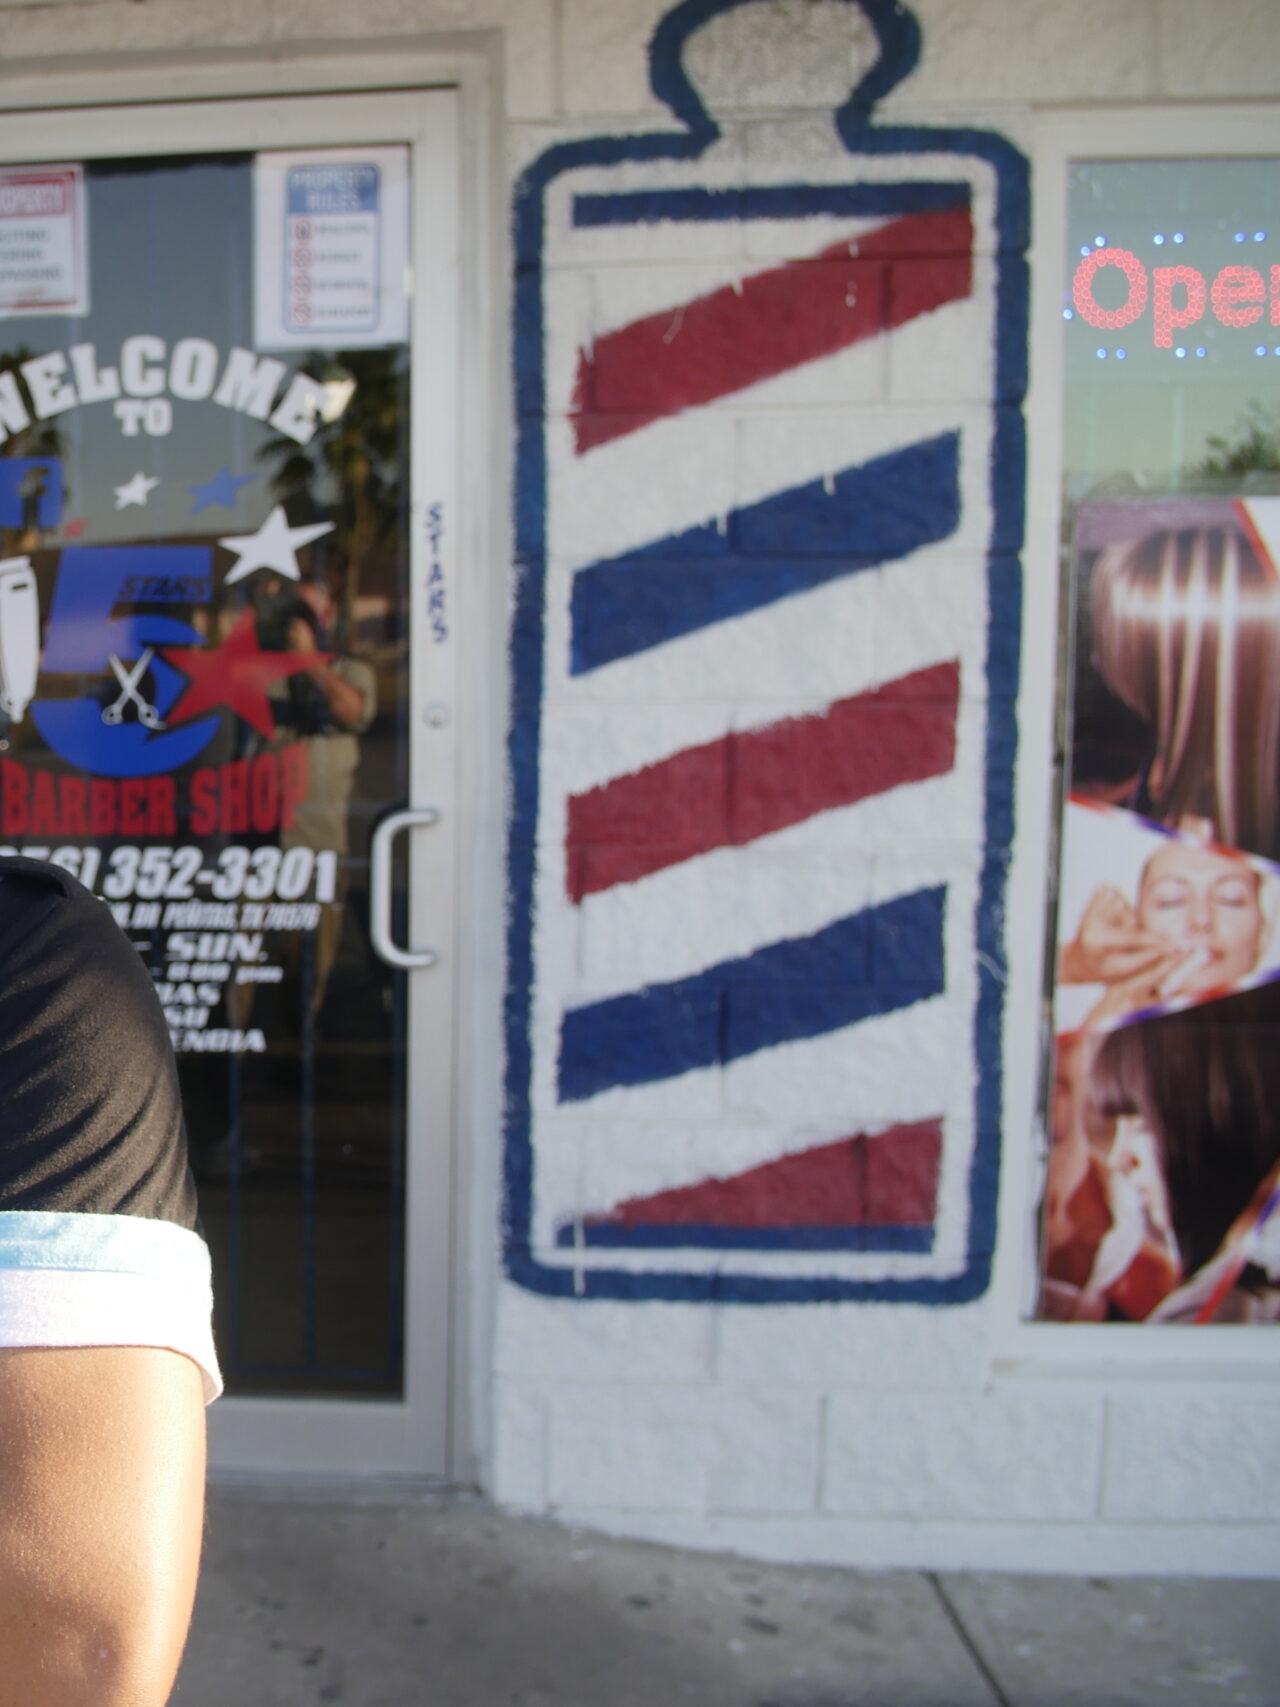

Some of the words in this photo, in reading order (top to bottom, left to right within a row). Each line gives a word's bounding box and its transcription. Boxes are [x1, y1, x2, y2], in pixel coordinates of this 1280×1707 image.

[1073, 248, 1280, 348] Ope
[114, 398, 173, 437] TO
[425, 502, 449, 645] STARS
[0, 757, 177, 838] BARBER
[189, 744, 309, 838] SHOP
[102, 846, 337, 901] 352-3301
